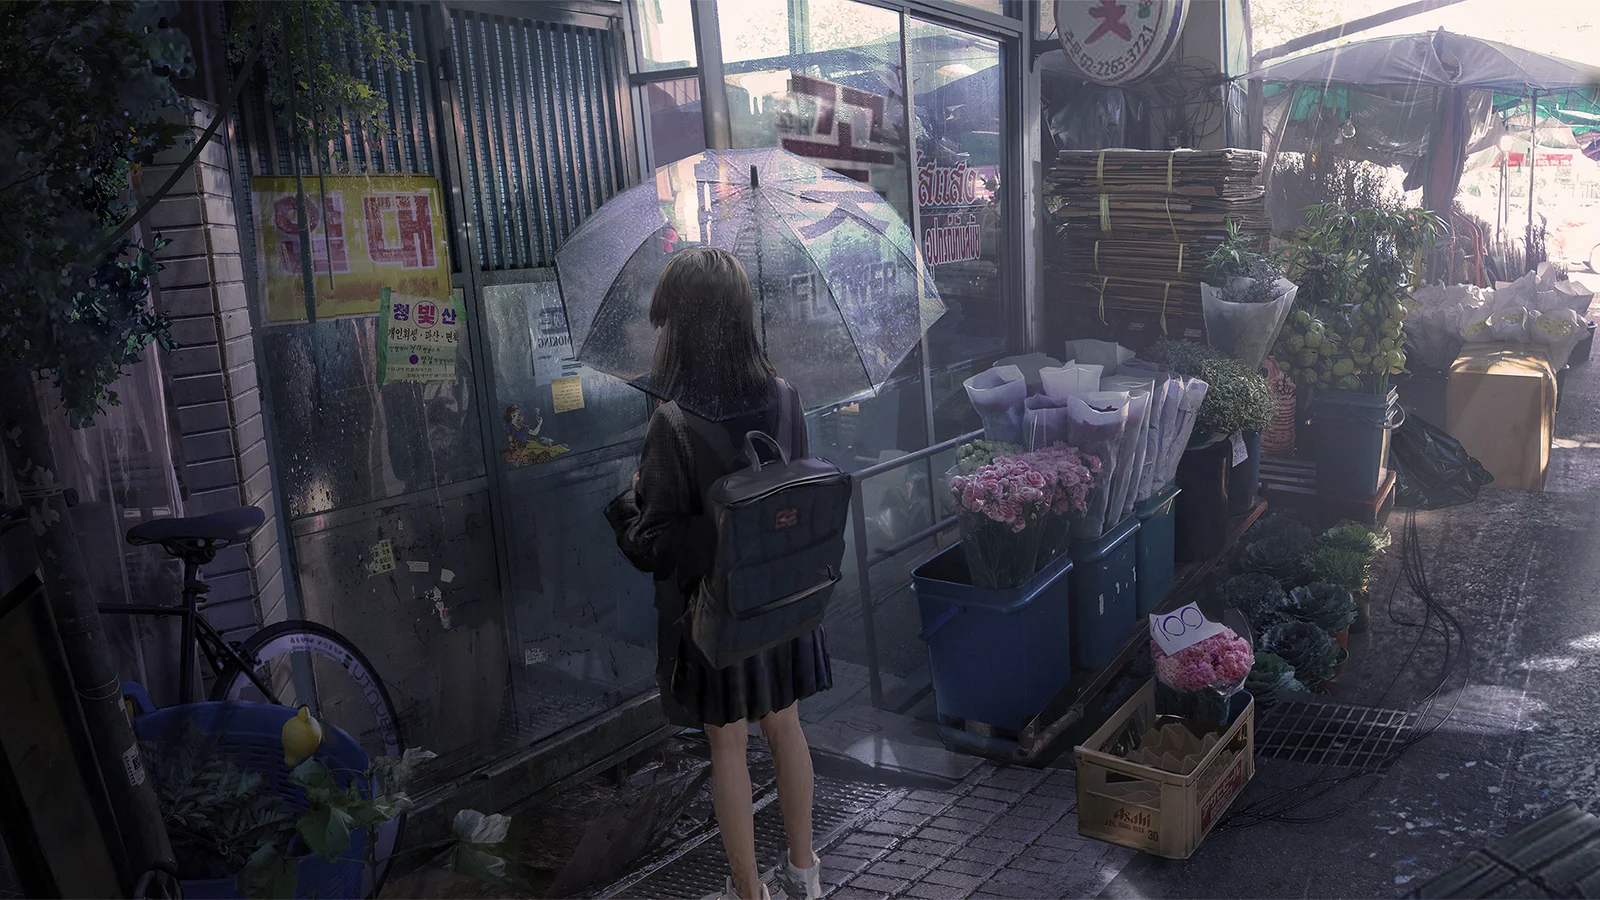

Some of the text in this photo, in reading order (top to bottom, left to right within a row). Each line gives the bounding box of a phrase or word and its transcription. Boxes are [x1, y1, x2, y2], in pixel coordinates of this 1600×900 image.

[1152, 606, 1203, 642] 100
[1113, 807, 1151, 828] Asahi
[1147, 829, 1159, 842] 30
